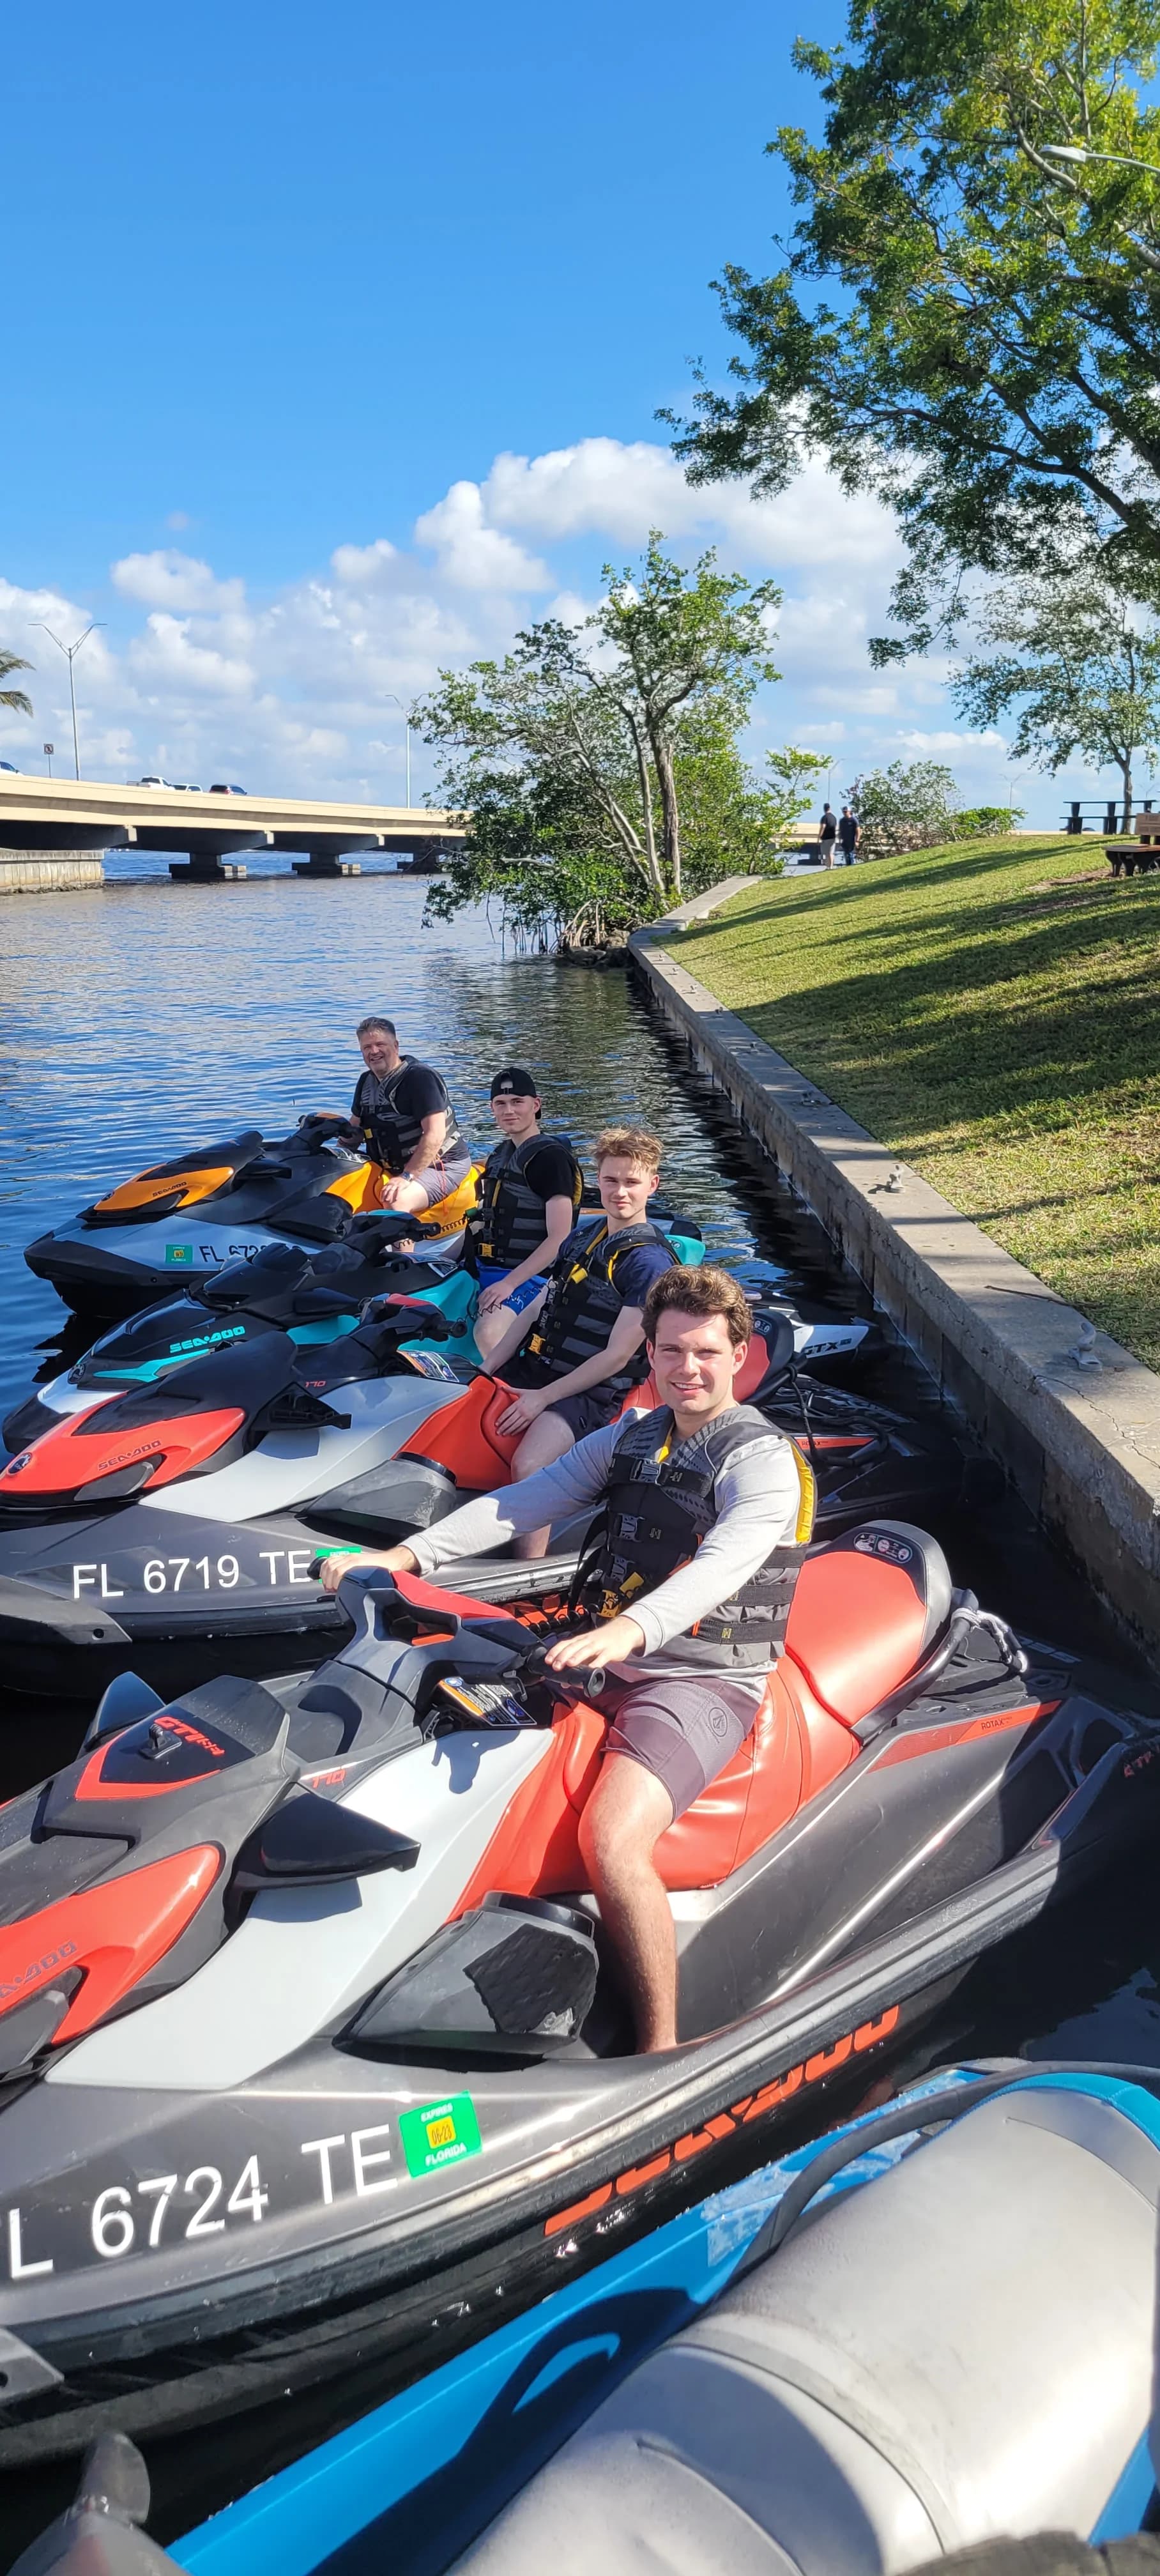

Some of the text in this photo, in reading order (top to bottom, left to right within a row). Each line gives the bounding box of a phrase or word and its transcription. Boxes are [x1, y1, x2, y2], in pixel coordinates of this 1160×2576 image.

[199, 1245, 225, 1262] FL
[72, 1549, 312, 1598] FL 6719 TE
[981, 1718, 1005, 1730] ROTAX
[425, 2142, 468, 2167] FLORIDA
[91, 2154, 270, 2258] 6724
[301, 2123, 399, 2205] TE
